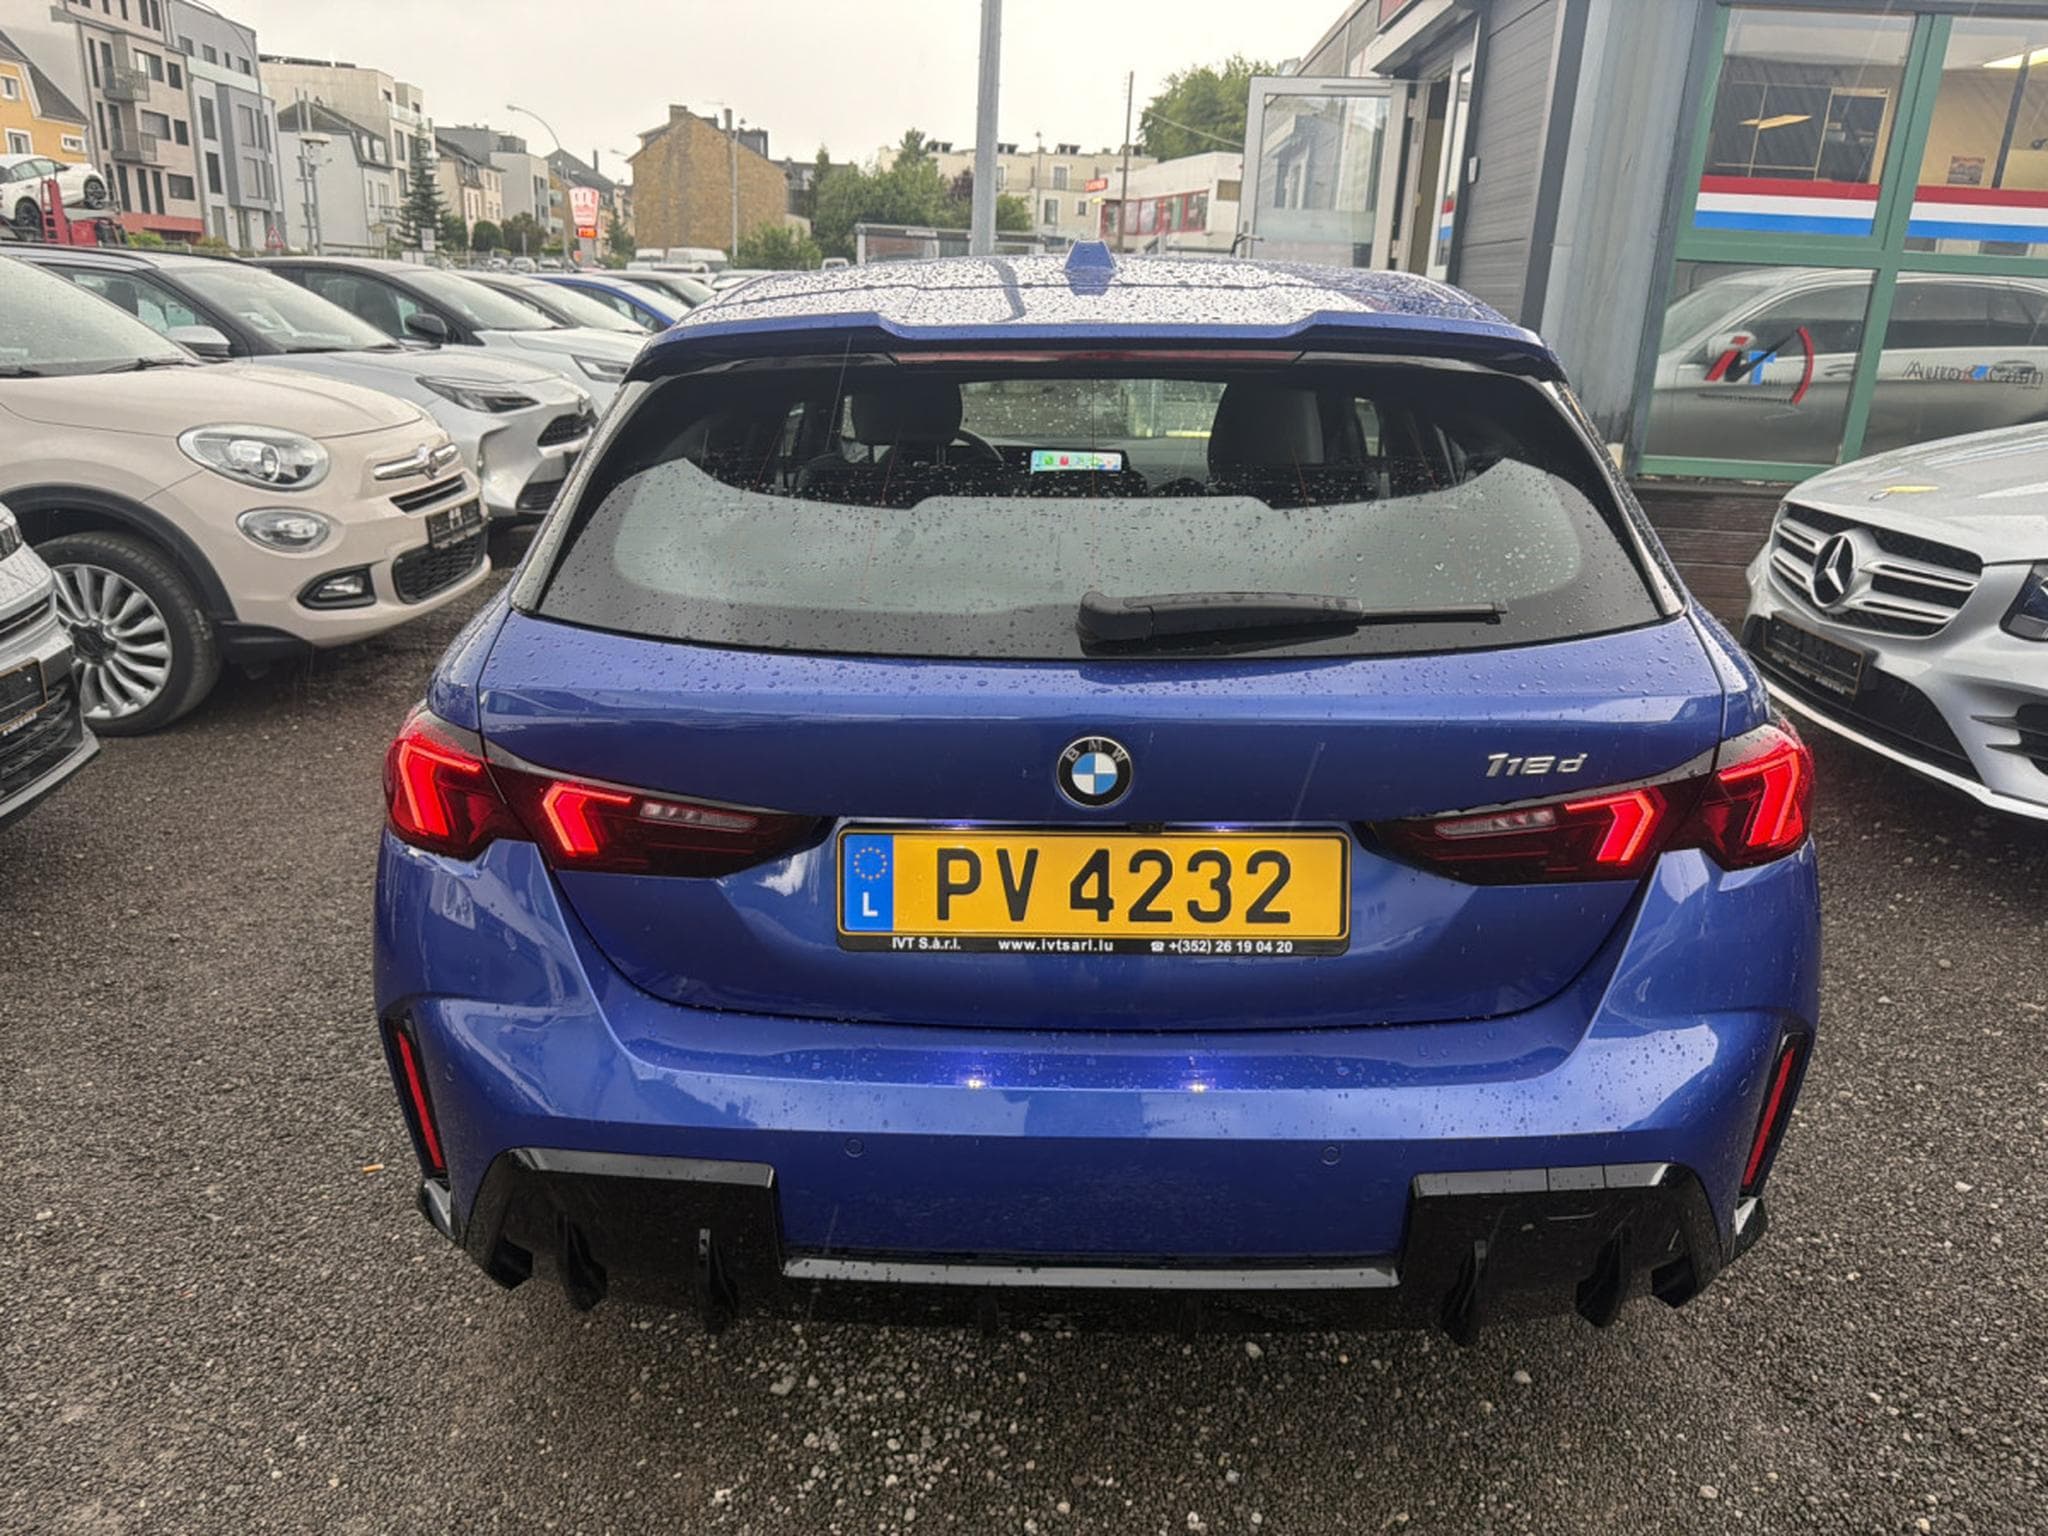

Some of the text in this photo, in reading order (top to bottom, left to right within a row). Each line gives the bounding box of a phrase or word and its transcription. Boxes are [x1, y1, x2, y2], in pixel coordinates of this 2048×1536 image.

[1065, 739, 1128, 763] BMW
[936, 847, 1292, 925] PV 4232
[862, 891, 879, 917] L
[891, 936, 915, 950] IVT
[998, 937, 1114, 952] www.ivtsarl.lu
[1168, 939, 1293, 954] +(352) 26 19 04 20
